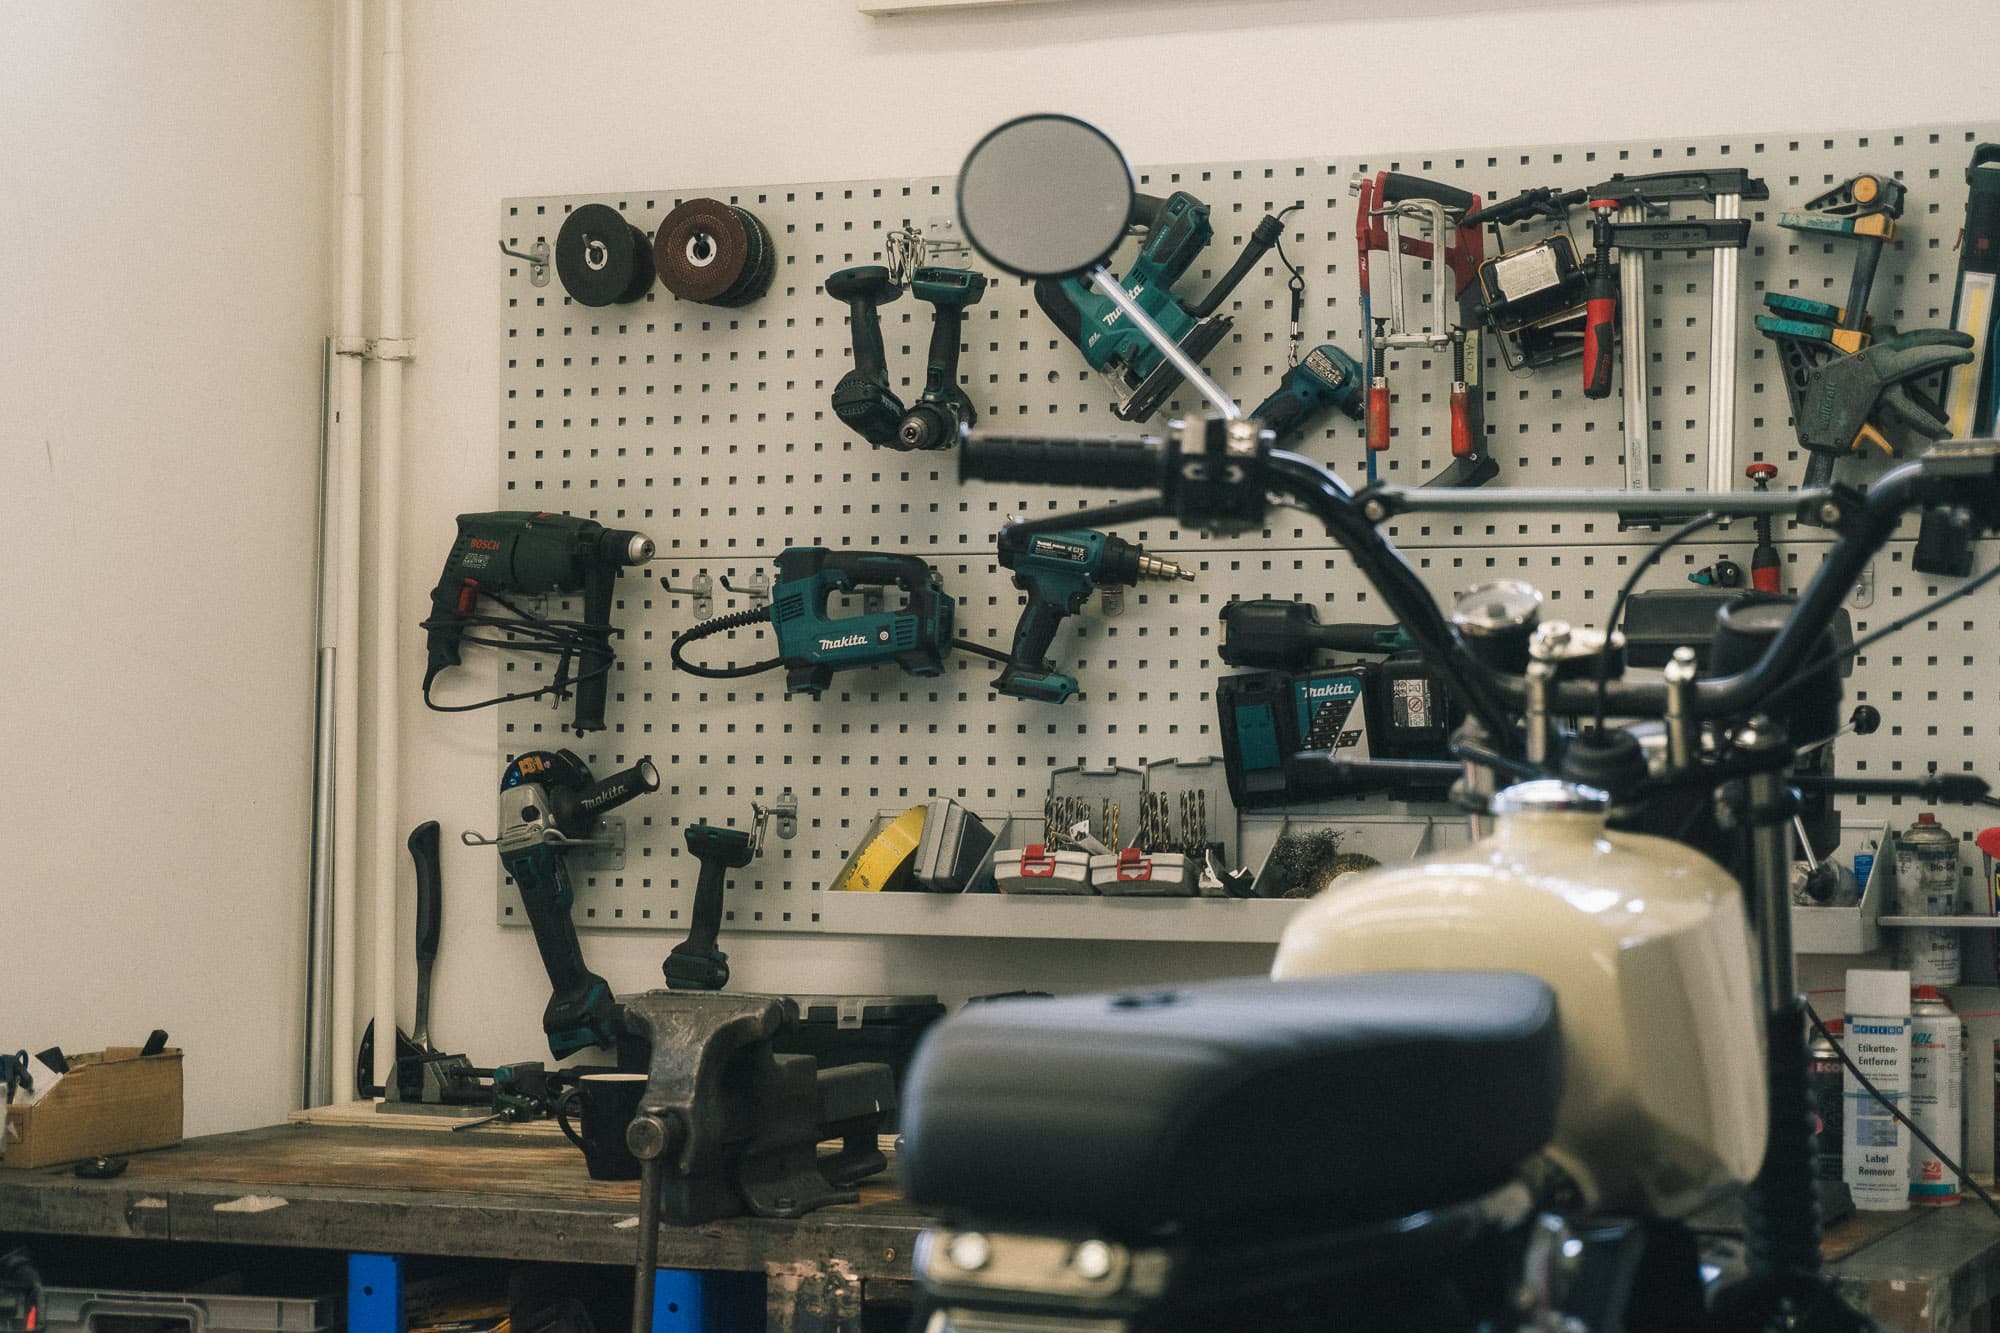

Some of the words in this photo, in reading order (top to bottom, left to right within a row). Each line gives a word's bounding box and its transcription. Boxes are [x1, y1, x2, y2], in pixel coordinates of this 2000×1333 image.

[1102, 284, 1145, 326] mata
[470, 537, 500, 551] BOSCH
[1858, 1043, 1898, 1053] Etiketten-
[1858, 1056, 1897, 1066] Entferner
[1865, 1154, 1889, 1163] Label
[1858, 1166, 1896, 1177] Remover
